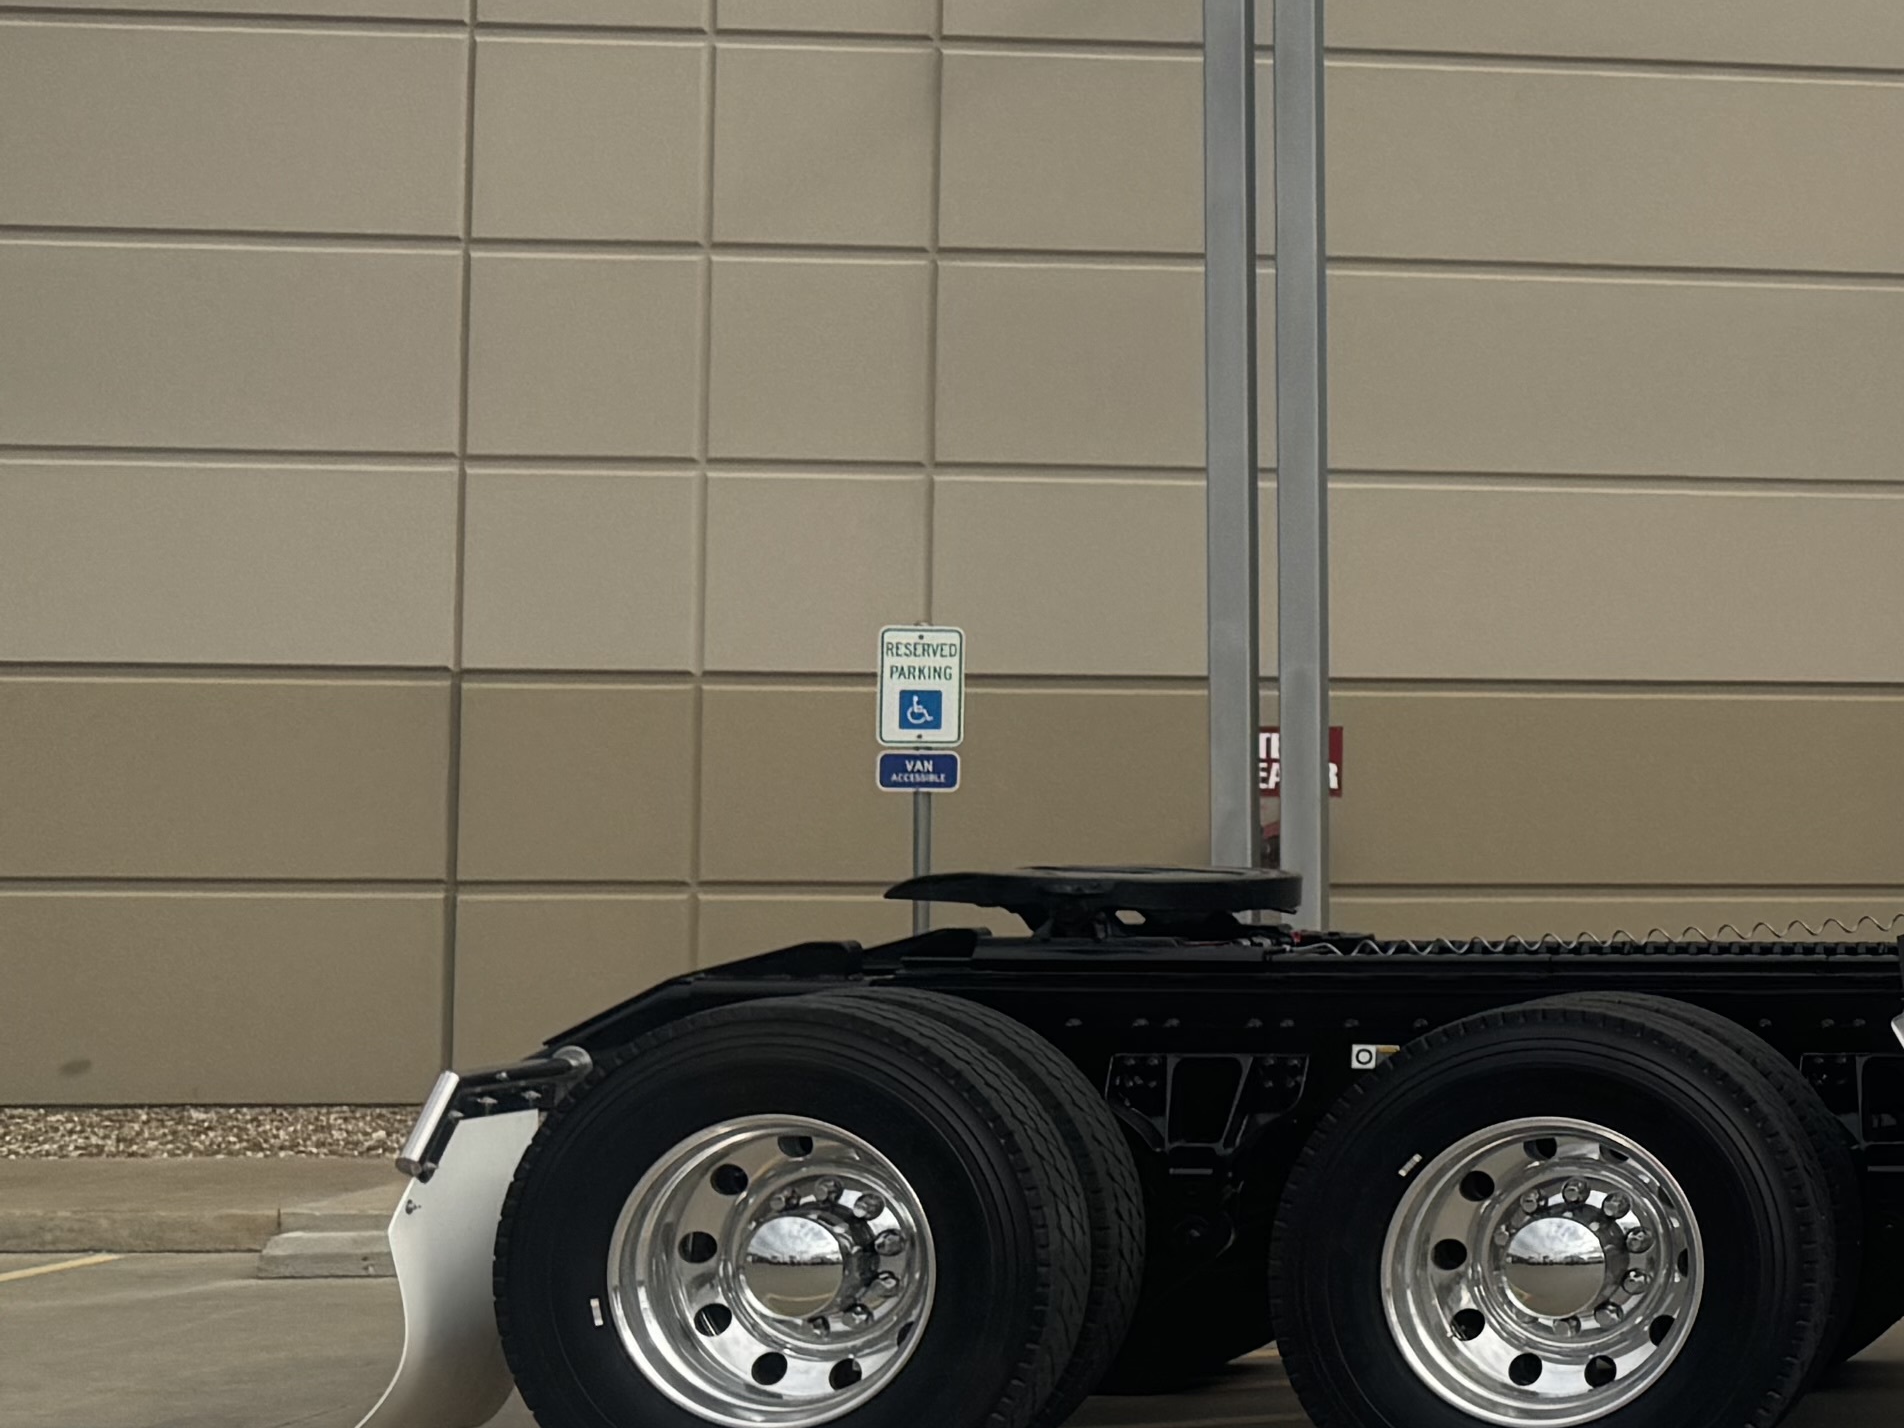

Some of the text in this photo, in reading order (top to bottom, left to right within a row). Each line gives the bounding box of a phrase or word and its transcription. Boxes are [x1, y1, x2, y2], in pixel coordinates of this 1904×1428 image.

[885, 641, 958, 658] RESERVED
[889, 665, 953, 681] PARKING
[904, 759, 934, 773] VAN
[890, 772, 946, 783] ACCESSIBLE
